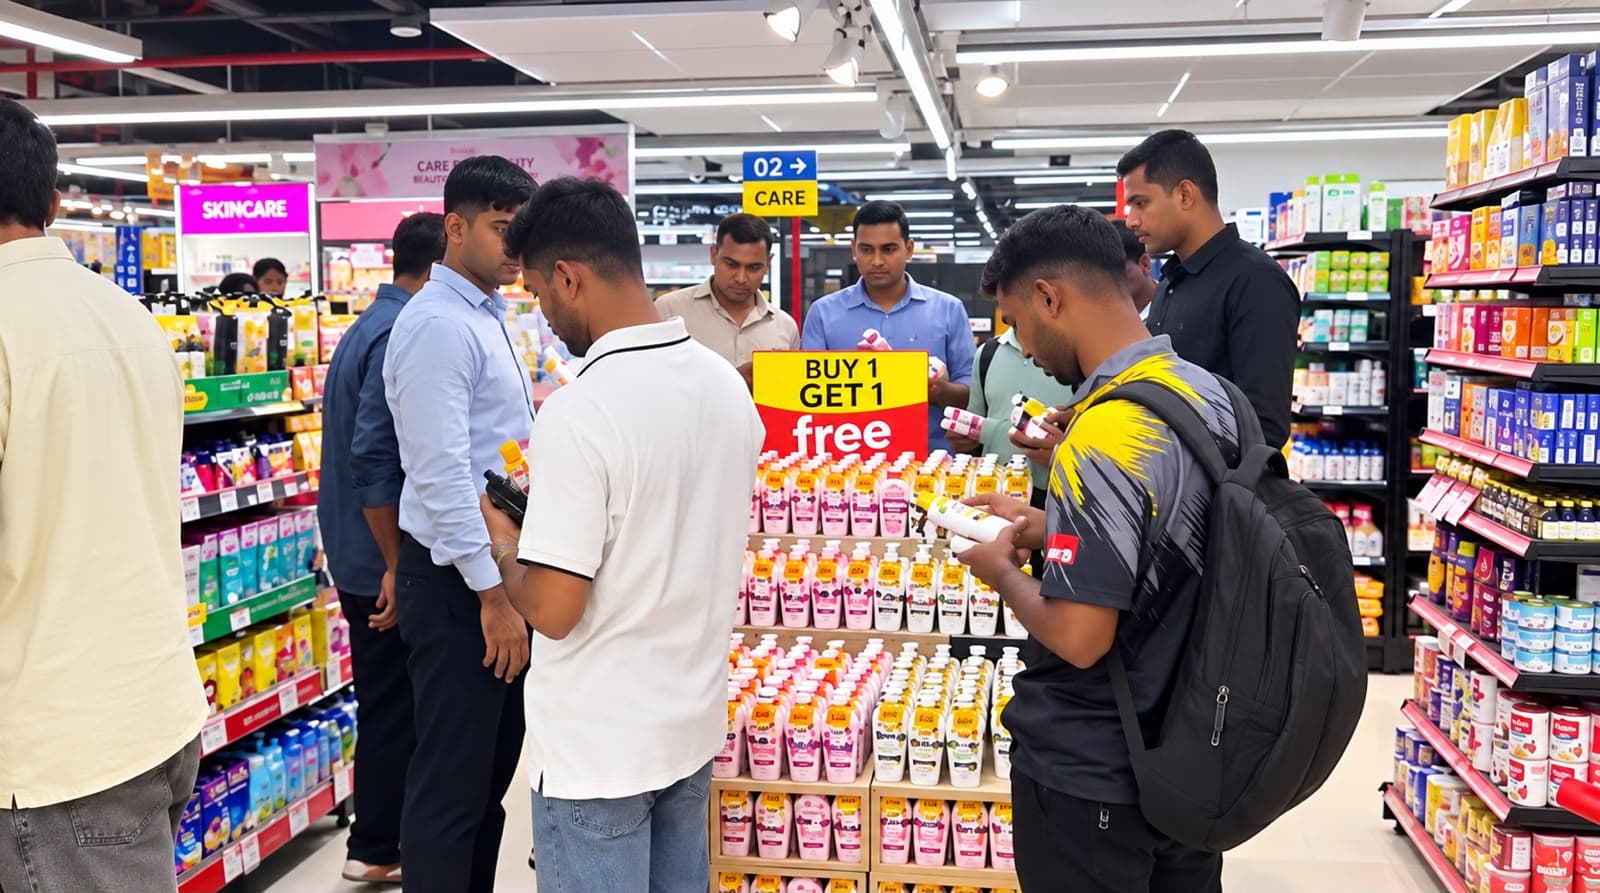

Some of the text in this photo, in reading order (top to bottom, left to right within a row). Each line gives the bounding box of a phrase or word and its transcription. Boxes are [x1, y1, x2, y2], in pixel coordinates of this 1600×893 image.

[417, 160, 448, 172] CARE
[753, 157, 783, 177] 02
[755, 190, 805, 206] CARE
[202, 199, 288, 219] SKINCARE
[806, 358, 877, 379] BUY 1
[800, 382, 882, 408] GET 1
[792, 415, 891, 454] free
